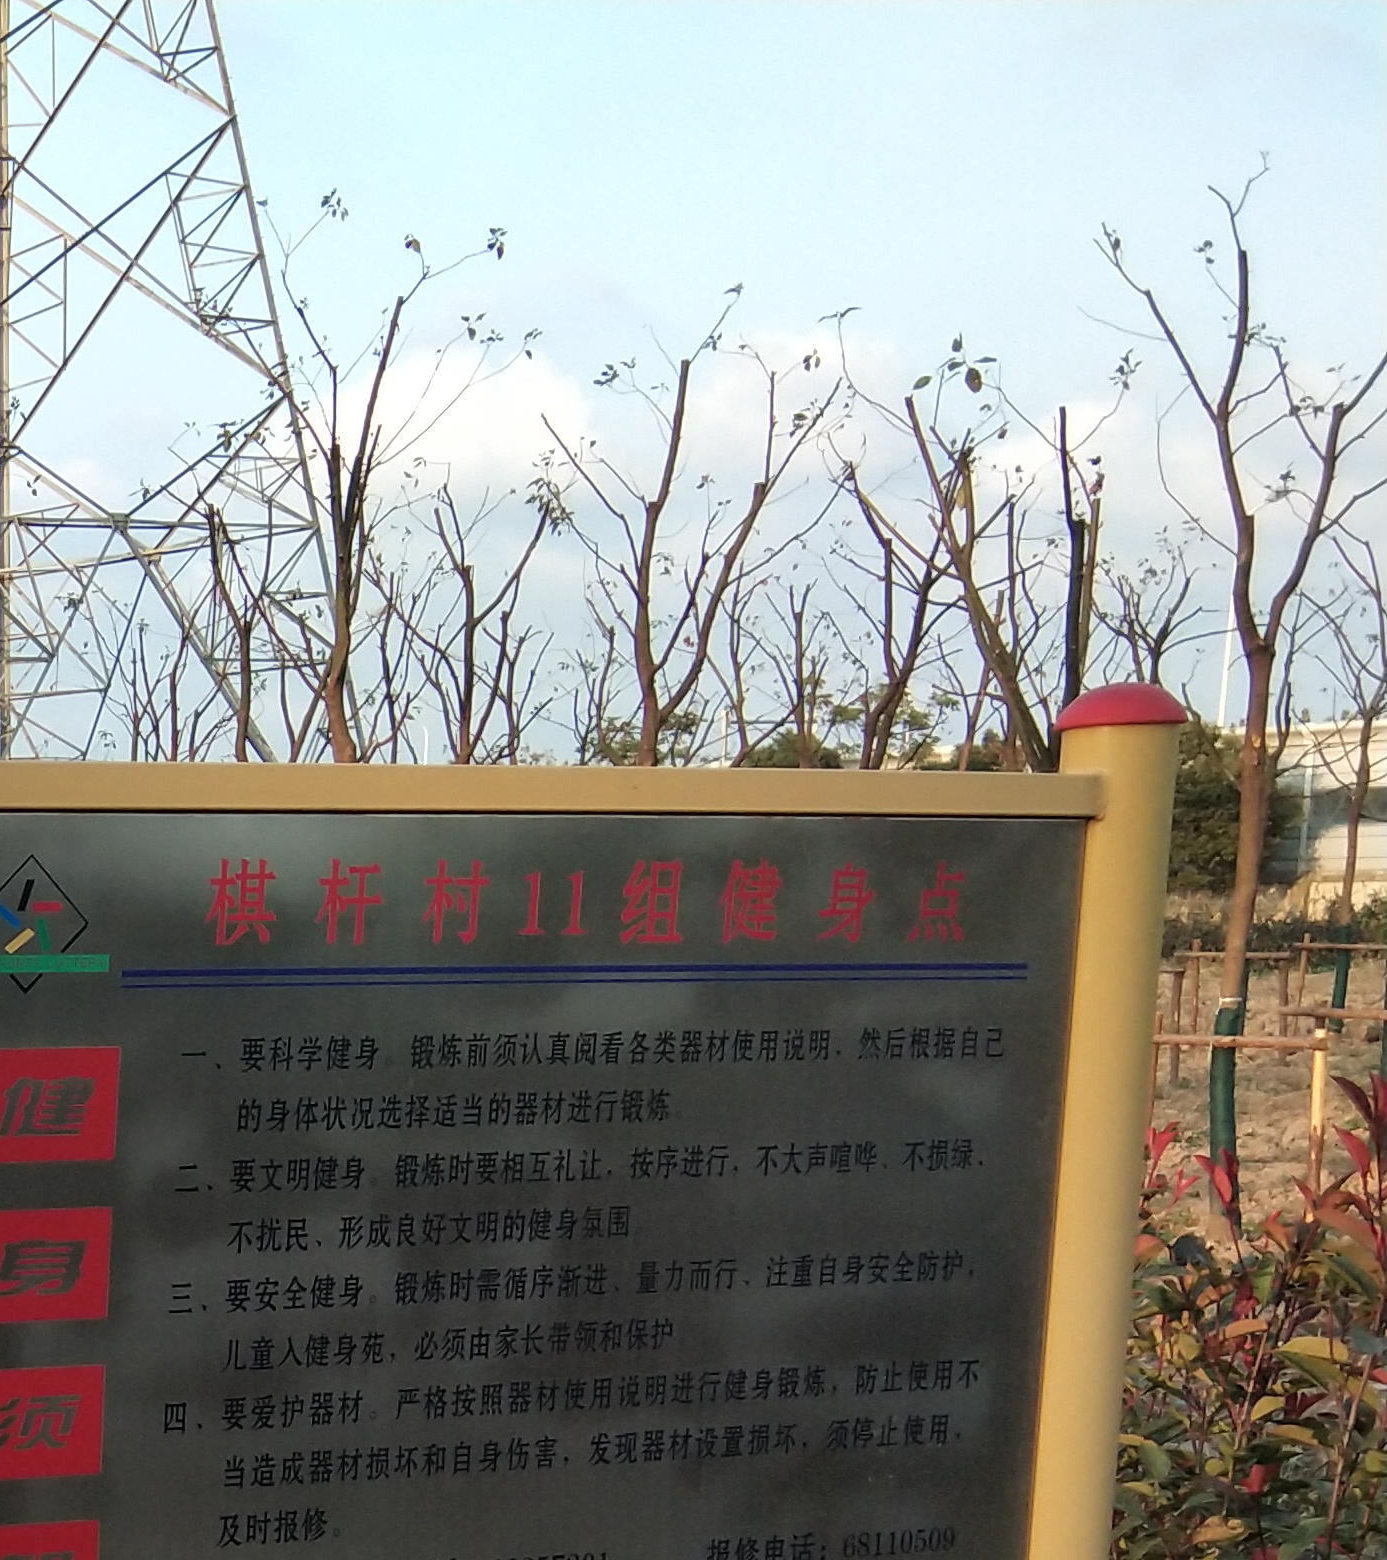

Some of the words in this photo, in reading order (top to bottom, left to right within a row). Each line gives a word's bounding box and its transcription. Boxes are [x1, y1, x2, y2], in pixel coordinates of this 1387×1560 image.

[205, 857, 966, 946] 棋杆村11组健身点
